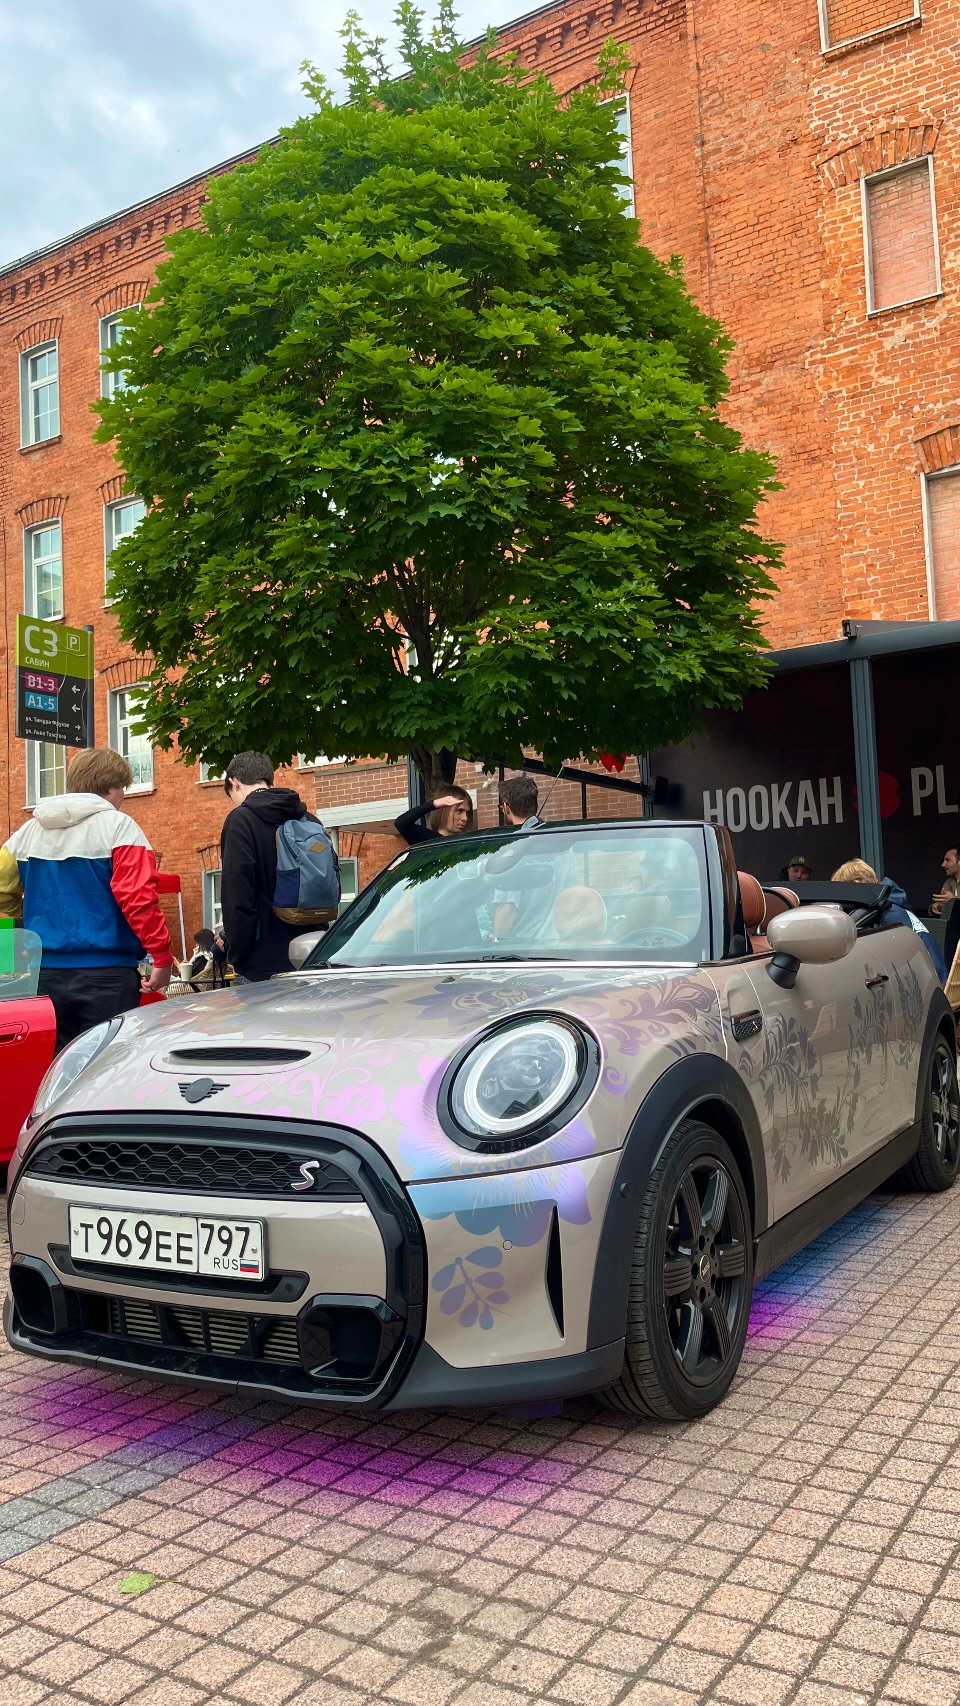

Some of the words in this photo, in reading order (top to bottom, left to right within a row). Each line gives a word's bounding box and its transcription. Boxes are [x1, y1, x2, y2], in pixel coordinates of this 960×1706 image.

[25, 656, 50, 669] САВИН
[28, 675, 55, 691] B1-3
[27, 694, 55, 710] A1-5
[702, 776, 844, 833] HOOKAH
[79, 1216, 193, 1265] T969EE
[200, 1222, 250, 1258] 797
[213, 1257, 239, 1270] RUS
